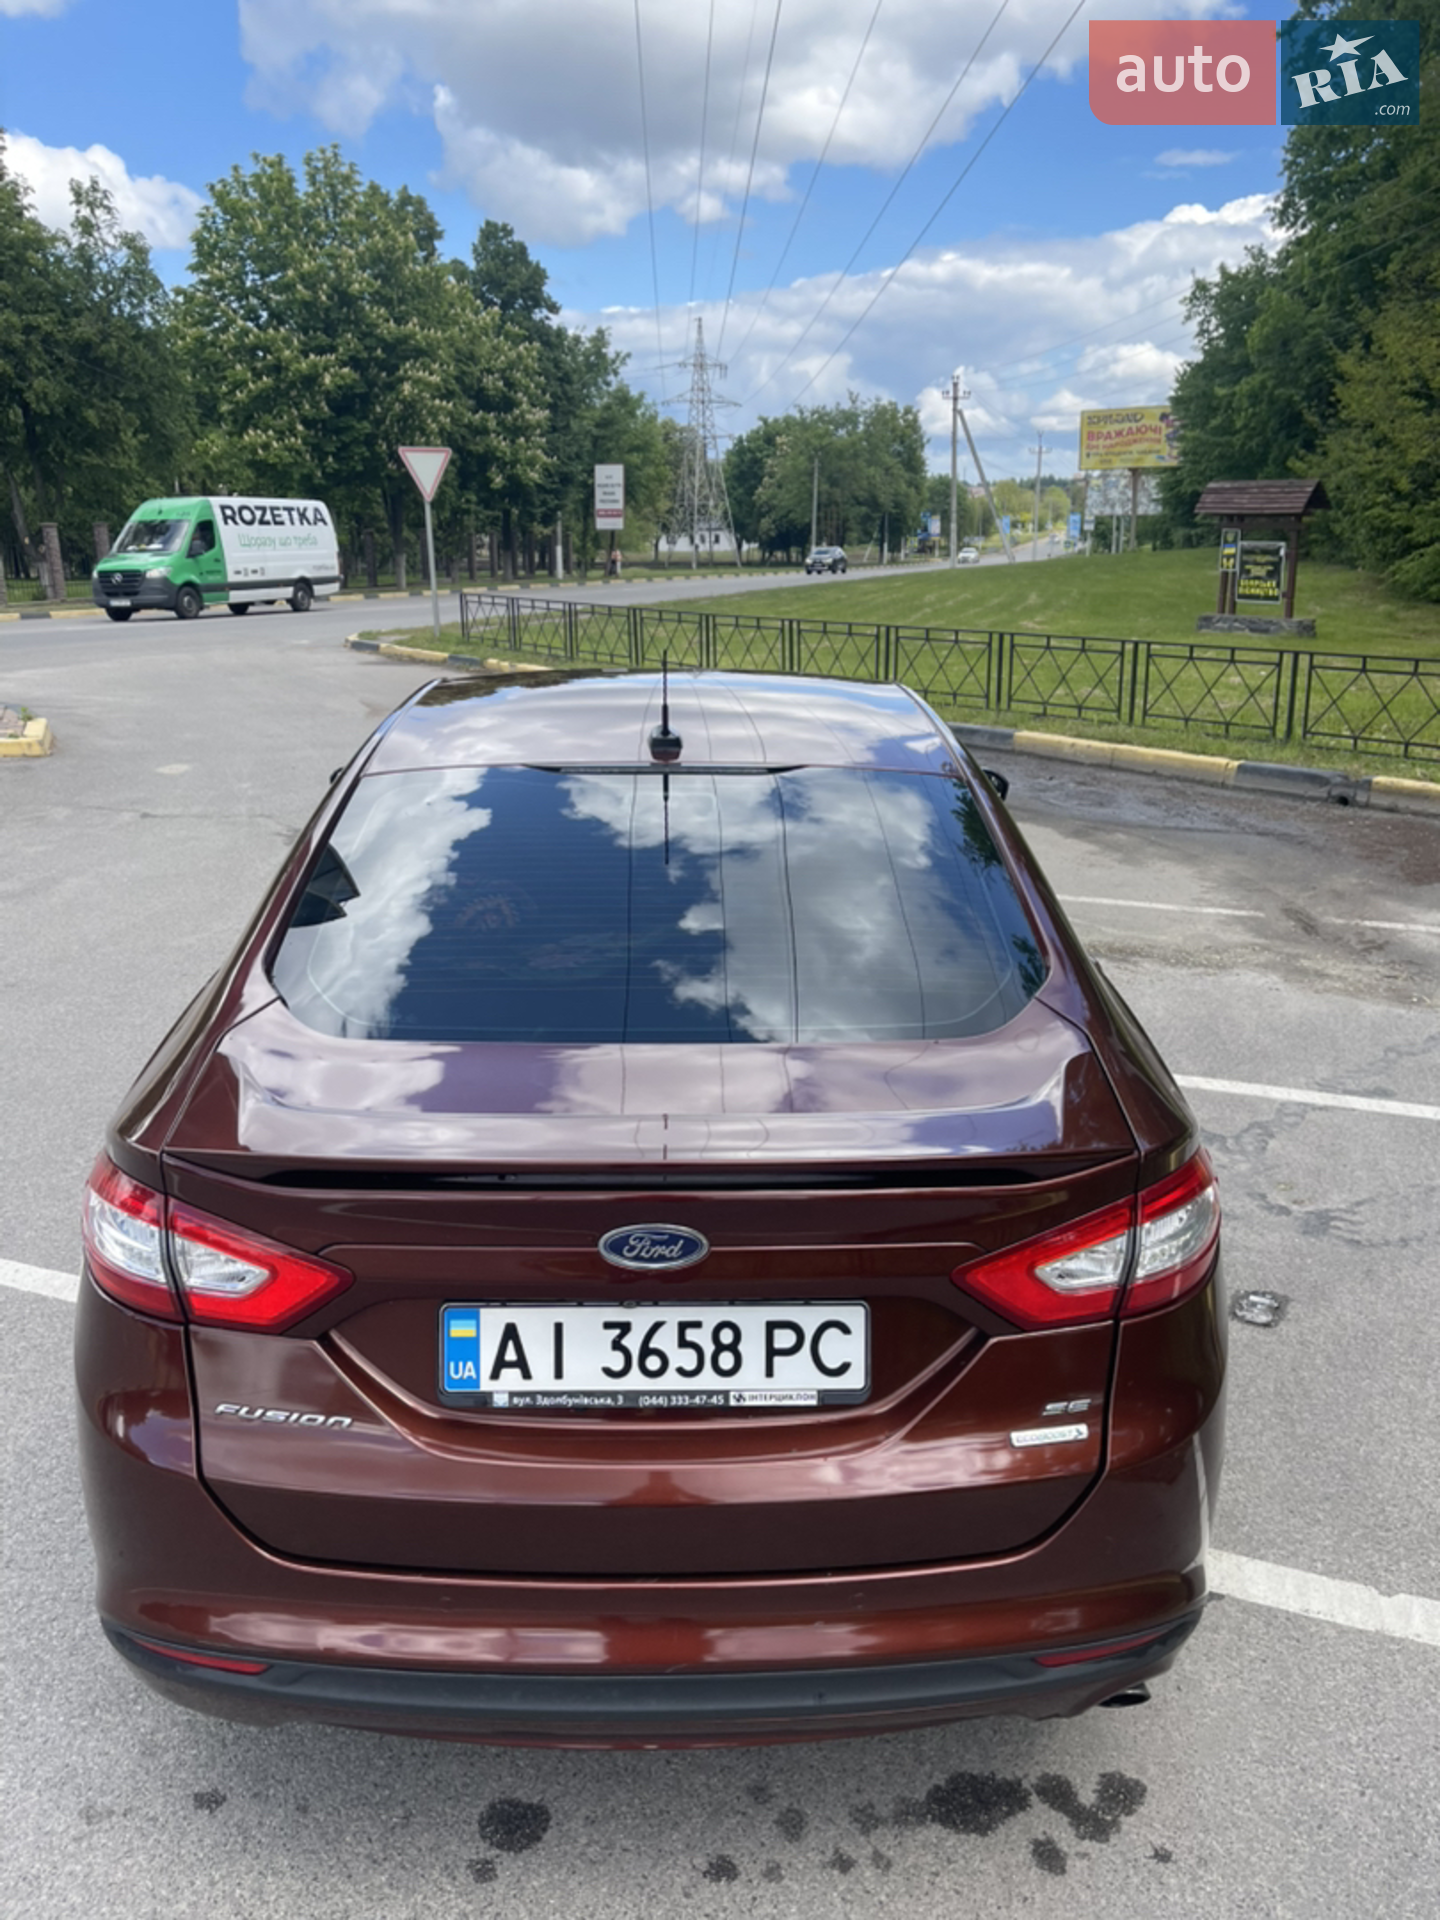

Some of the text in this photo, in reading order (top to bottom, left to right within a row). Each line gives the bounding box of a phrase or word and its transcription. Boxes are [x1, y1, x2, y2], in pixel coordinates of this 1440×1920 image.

[219, 505, 328, 526] ROZETKA
[623, 1234, 684, 1257] Ford
[489, 1320, 852, 1380] AI 3658 PC
[449, 1361, 477, 1380] UA
[616, 1395, 624, 1405] 3
[638, 1395, 668, 1407] (044)
[670, 1394, 725, 1405] 333-47-45
[214, 1403, 353, 1428] FUSION
